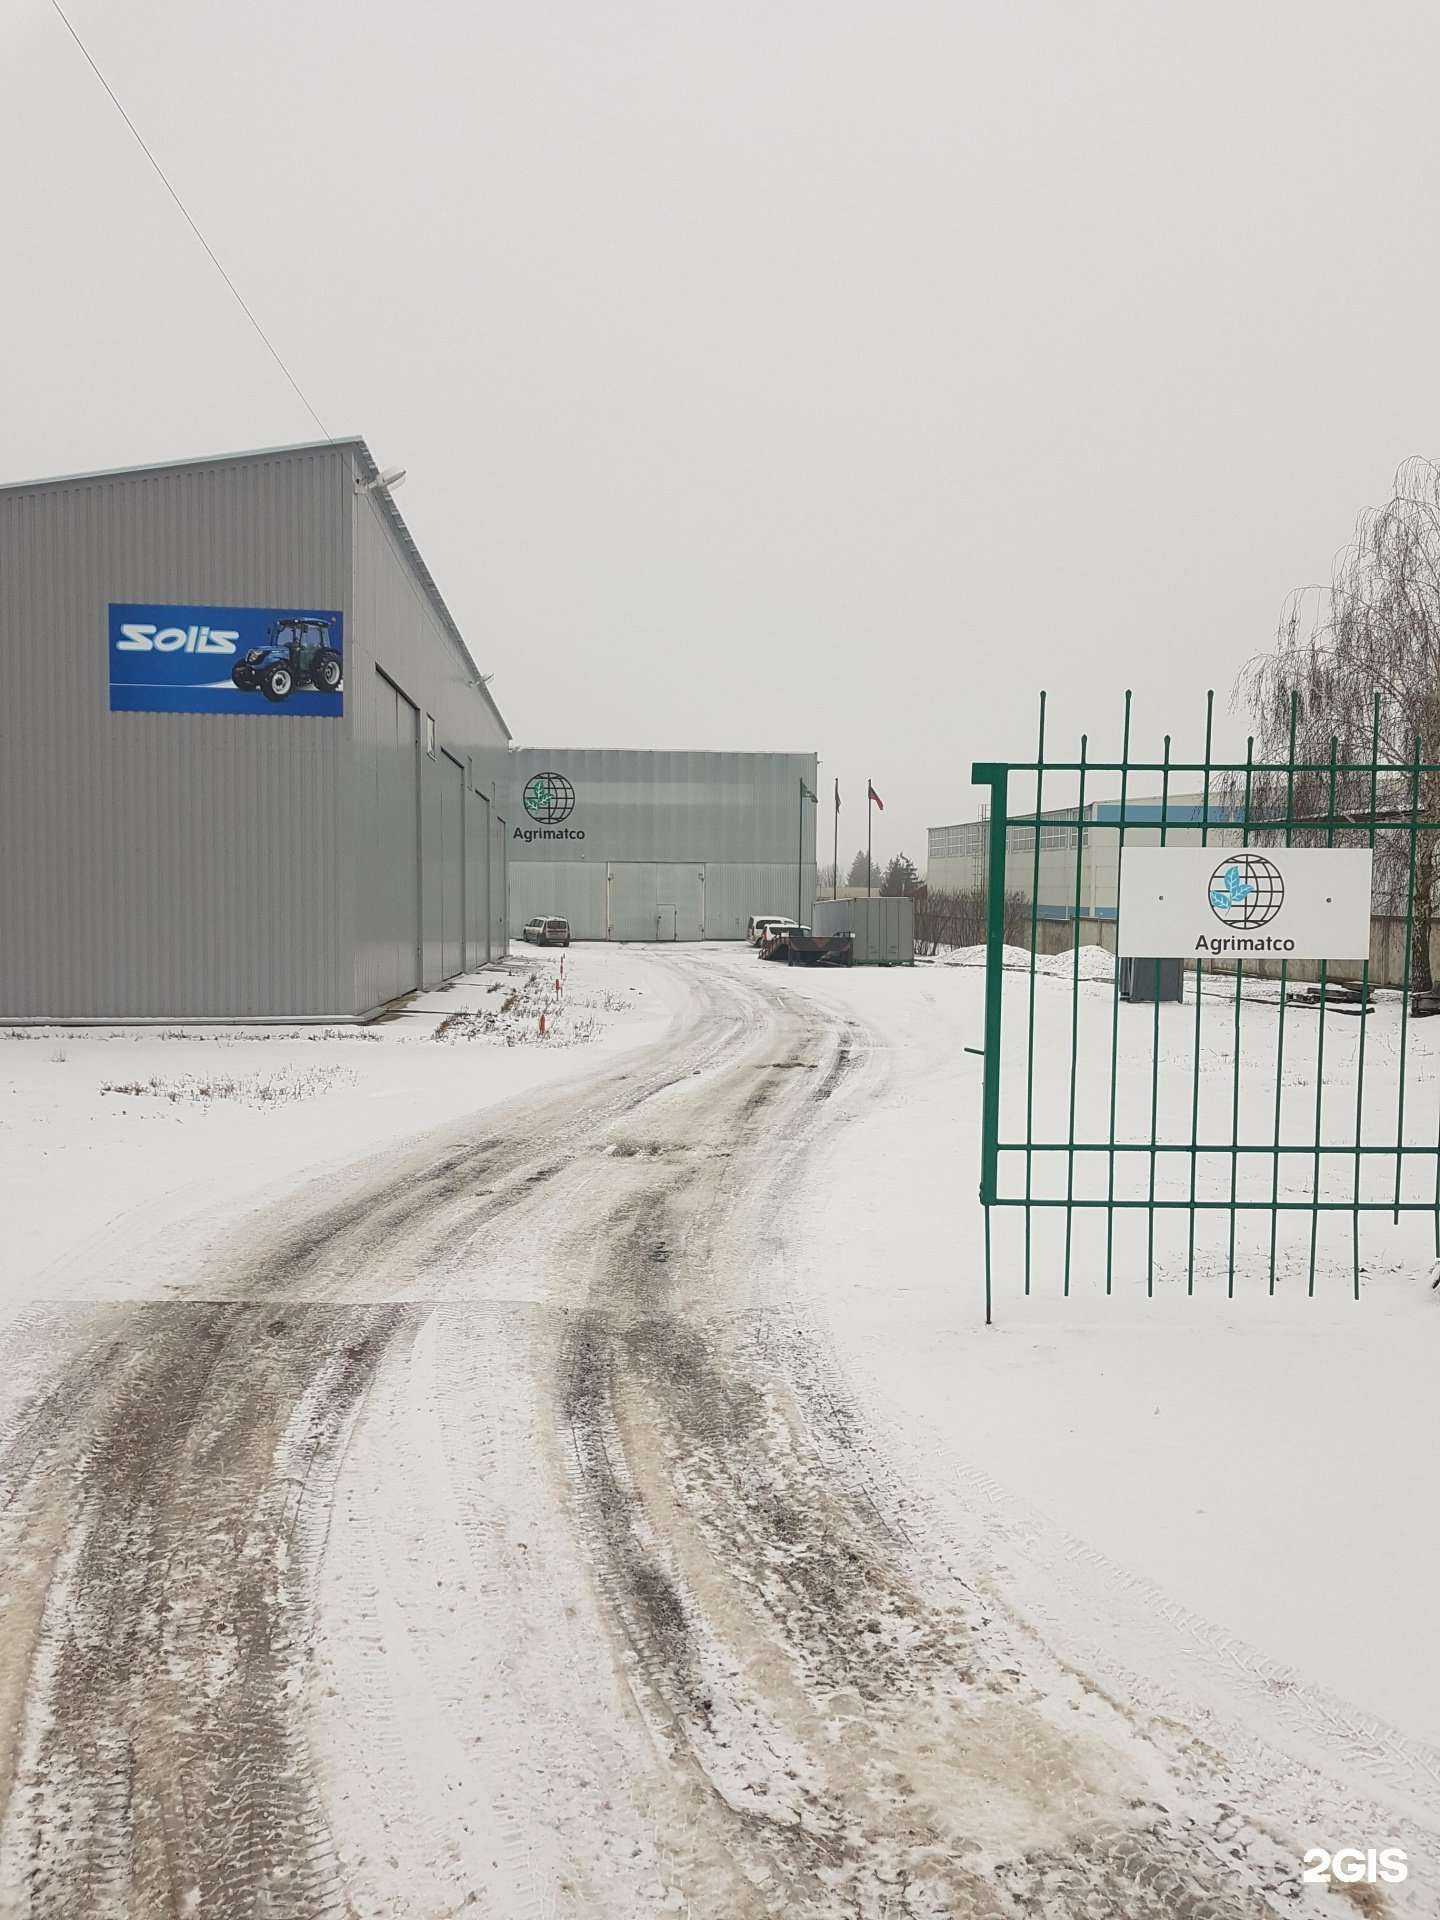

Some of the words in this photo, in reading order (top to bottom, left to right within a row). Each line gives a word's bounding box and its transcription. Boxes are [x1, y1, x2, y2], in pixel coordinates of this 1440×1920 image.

[116, 623, 240, 655] Solis
[513, 827, 586, 843] Agrimatco
[1195, 935, 1295, 955] Agrimatco
